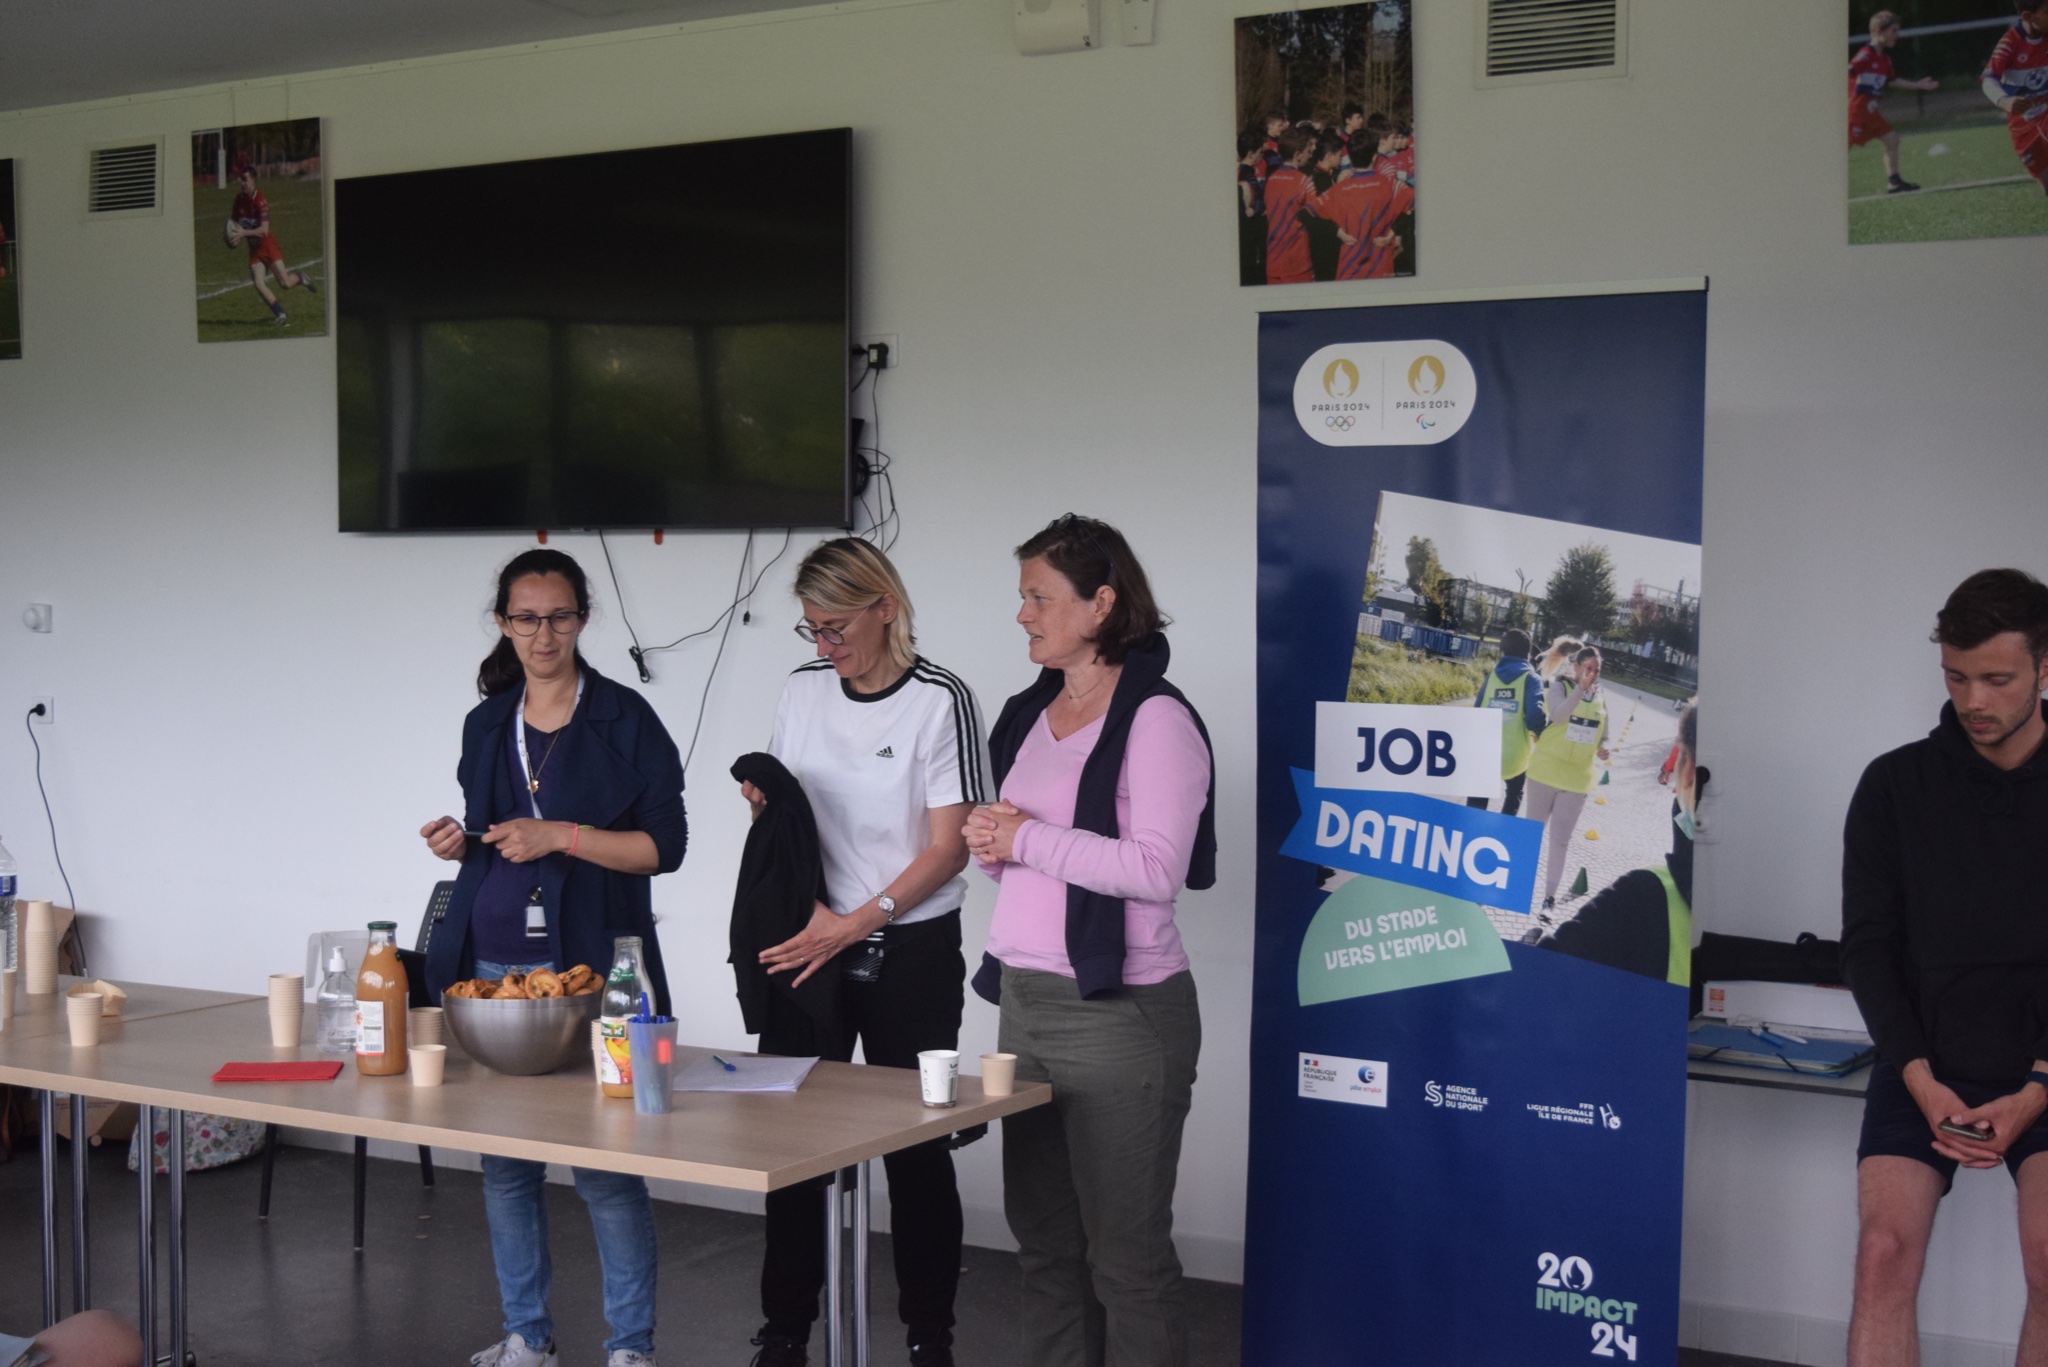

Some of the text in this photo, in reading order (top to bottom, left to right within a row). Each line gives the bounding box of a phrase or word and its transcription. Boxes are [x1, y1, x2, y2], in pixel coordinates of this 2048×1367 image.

[1312, 403, 1370, 412] PARIS 2024
[1396, 400, 1456, 409] PARIS 2024
[1356, 727, 1457, 777] JOB
[1315, 800, 1511, 890] DATING
[1344, 905, 1438, 940] DU STADE
[1324, 927, 1468, 970] VERS L'EMPLOI
[1303, 1067, 1337, 1076] RÉPUBLIQUE
[1303, 1073, 1335, 1082] FRANÇAISE
[1446, 1085, 1477, 1095] AGENCE
[1446, 1092, 1488, 1104] NATIONALE
[1445, 1100, 1484, 1111] DU SPORT
[1526, 1103, 1594, 1117] LIGUE RÉGIONALE
[1538, 1110, 1594, 1125] ÎLE DE FRANCE
[1537, 1252, 1593, 1291] 20
[1536, 1286, 1638, 1325] IMPACT
[1591, 1321, 1637, 1361] 24
